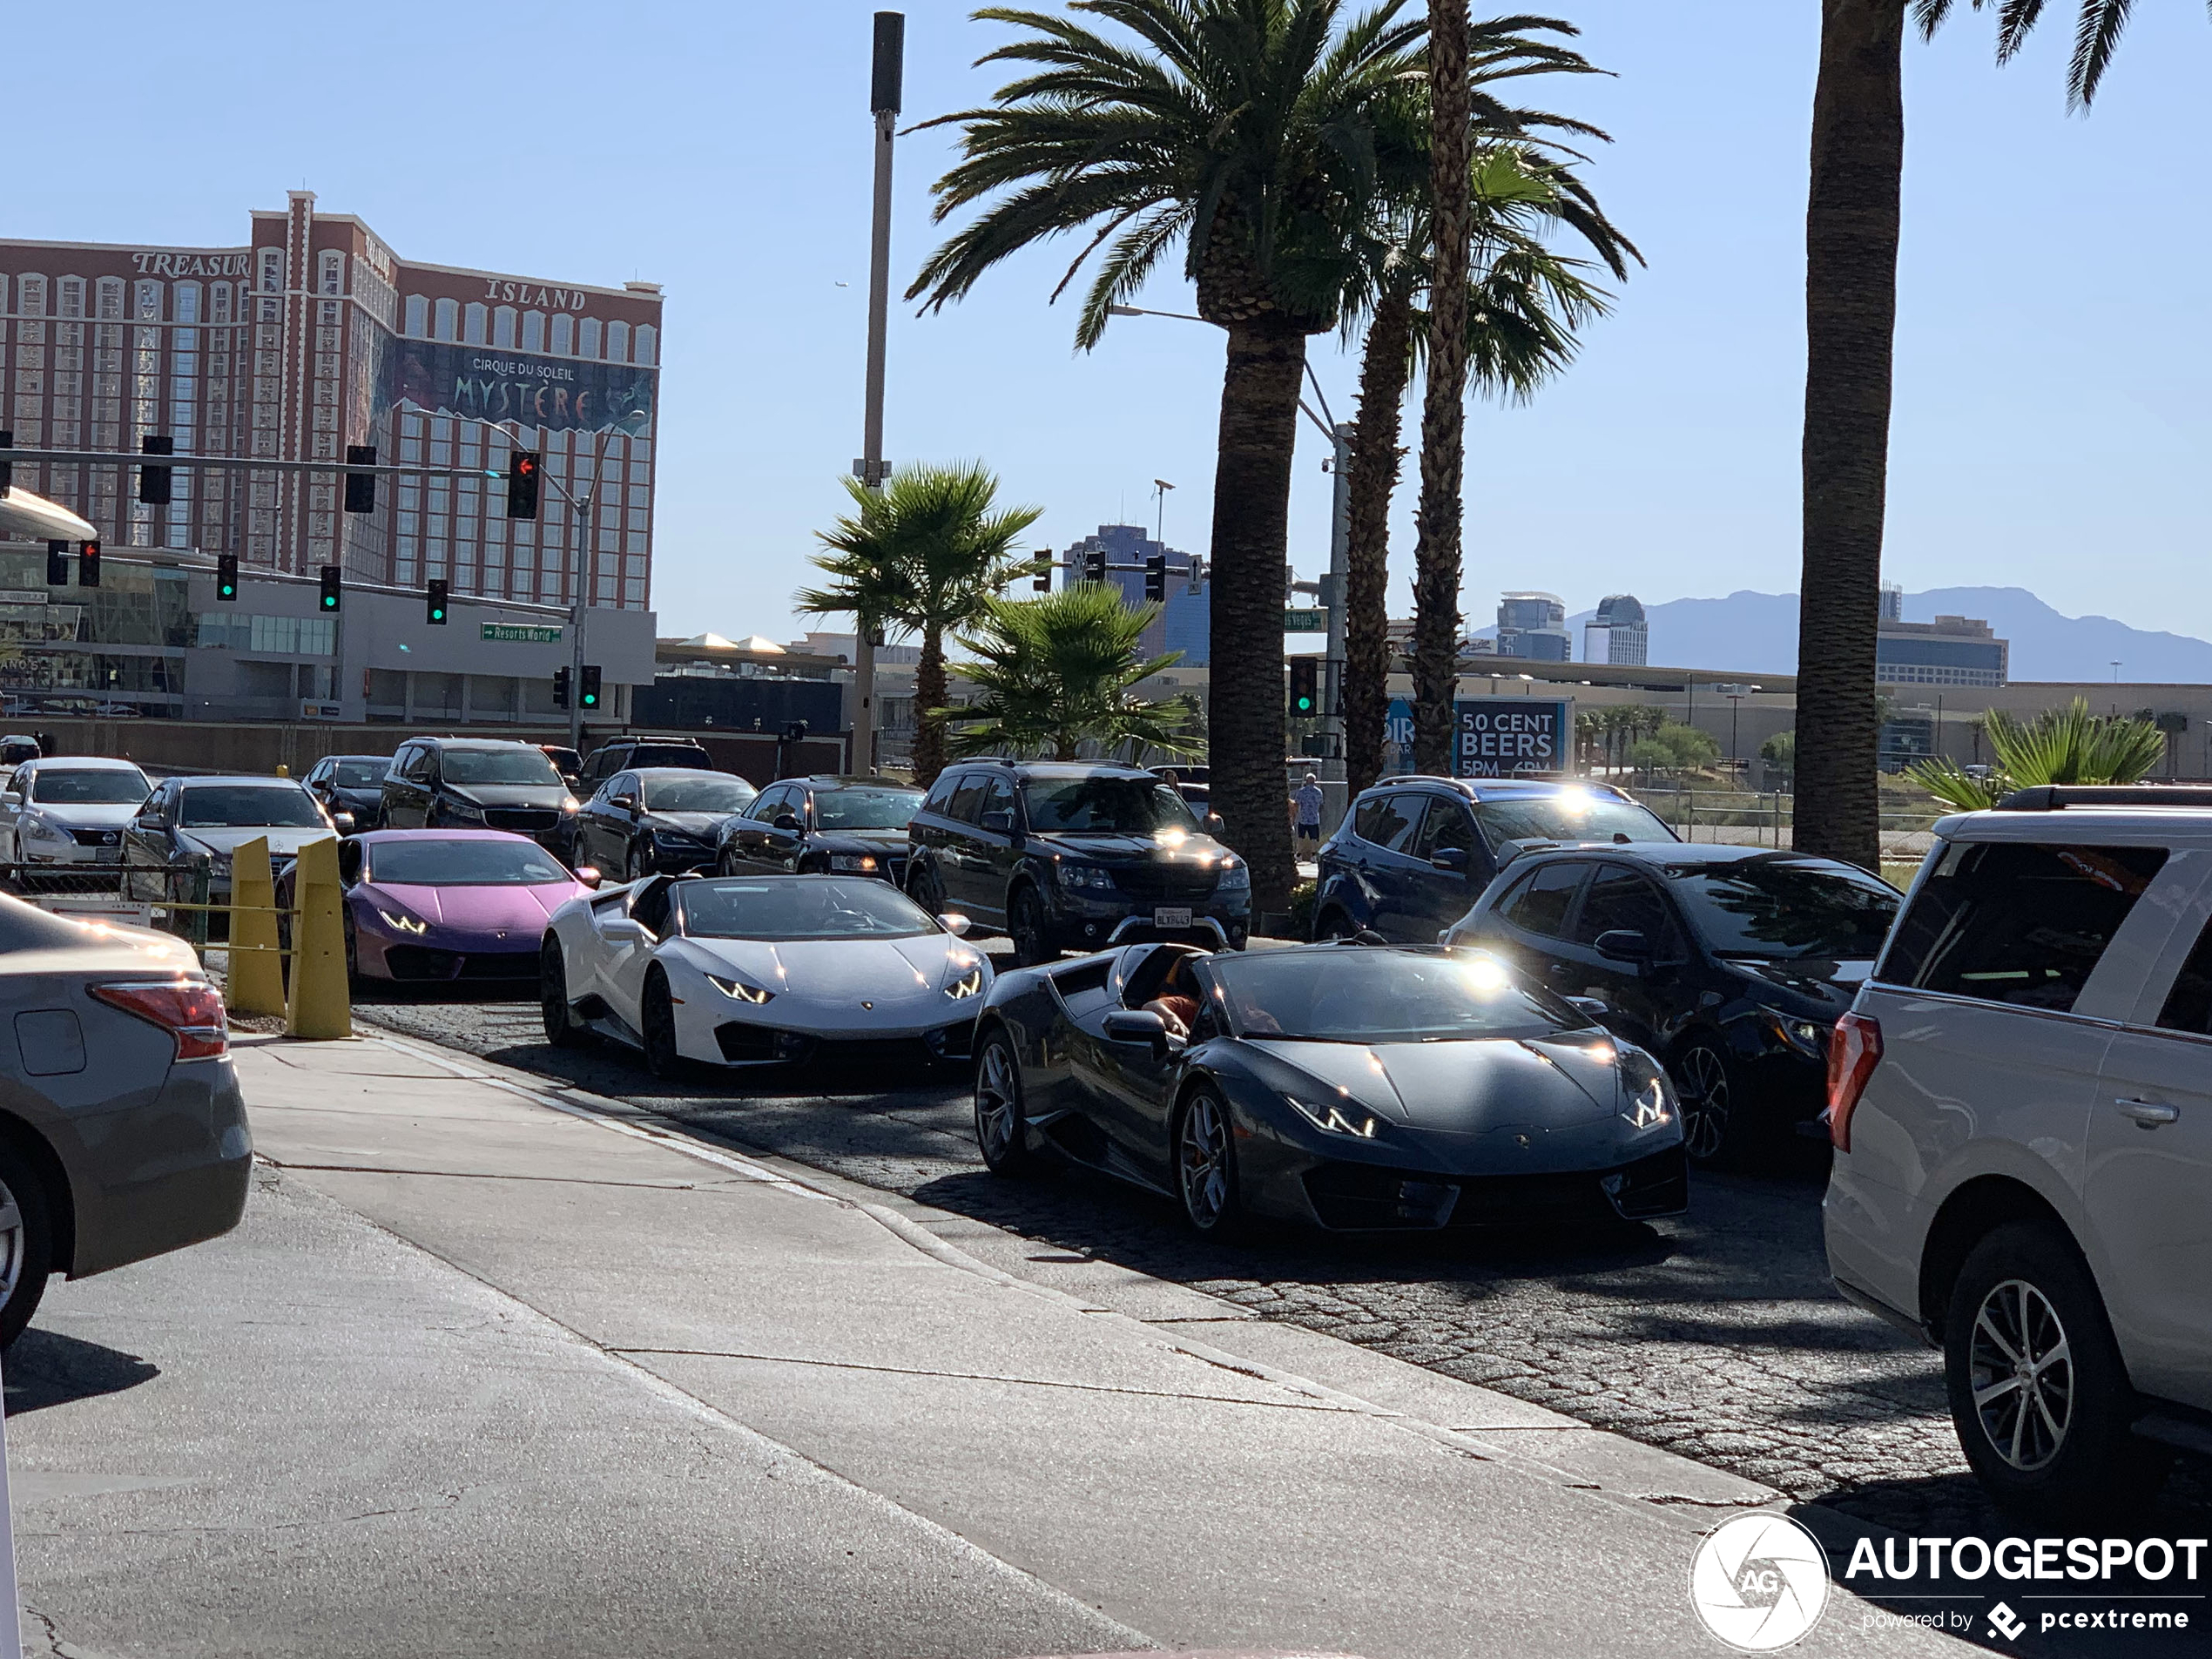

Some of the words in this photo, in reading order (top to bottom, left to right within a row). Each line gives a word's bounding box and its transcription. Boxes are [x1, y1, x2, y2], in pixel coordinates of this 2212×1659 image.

[132, 252, 251, 279] TREASUR
[485, 279, 586, 311] ISLAND
[473, 358, 516, 377] CIRQUE
[518, 362, 534, 375] DU
[536, 366, 574, 381] SOLEIL
[454, 376, 590, 421] MYSTÈRE
[495, 627, 526, 640] Resorts
[527, 628, 550, 642] World
[1463, 713, 1488, 732] 50
[1494, 713, 1554, 732] CENT
[1462, 733, 1553, 758] BEERS
[1462, 760, 1499, 777] 5PM
